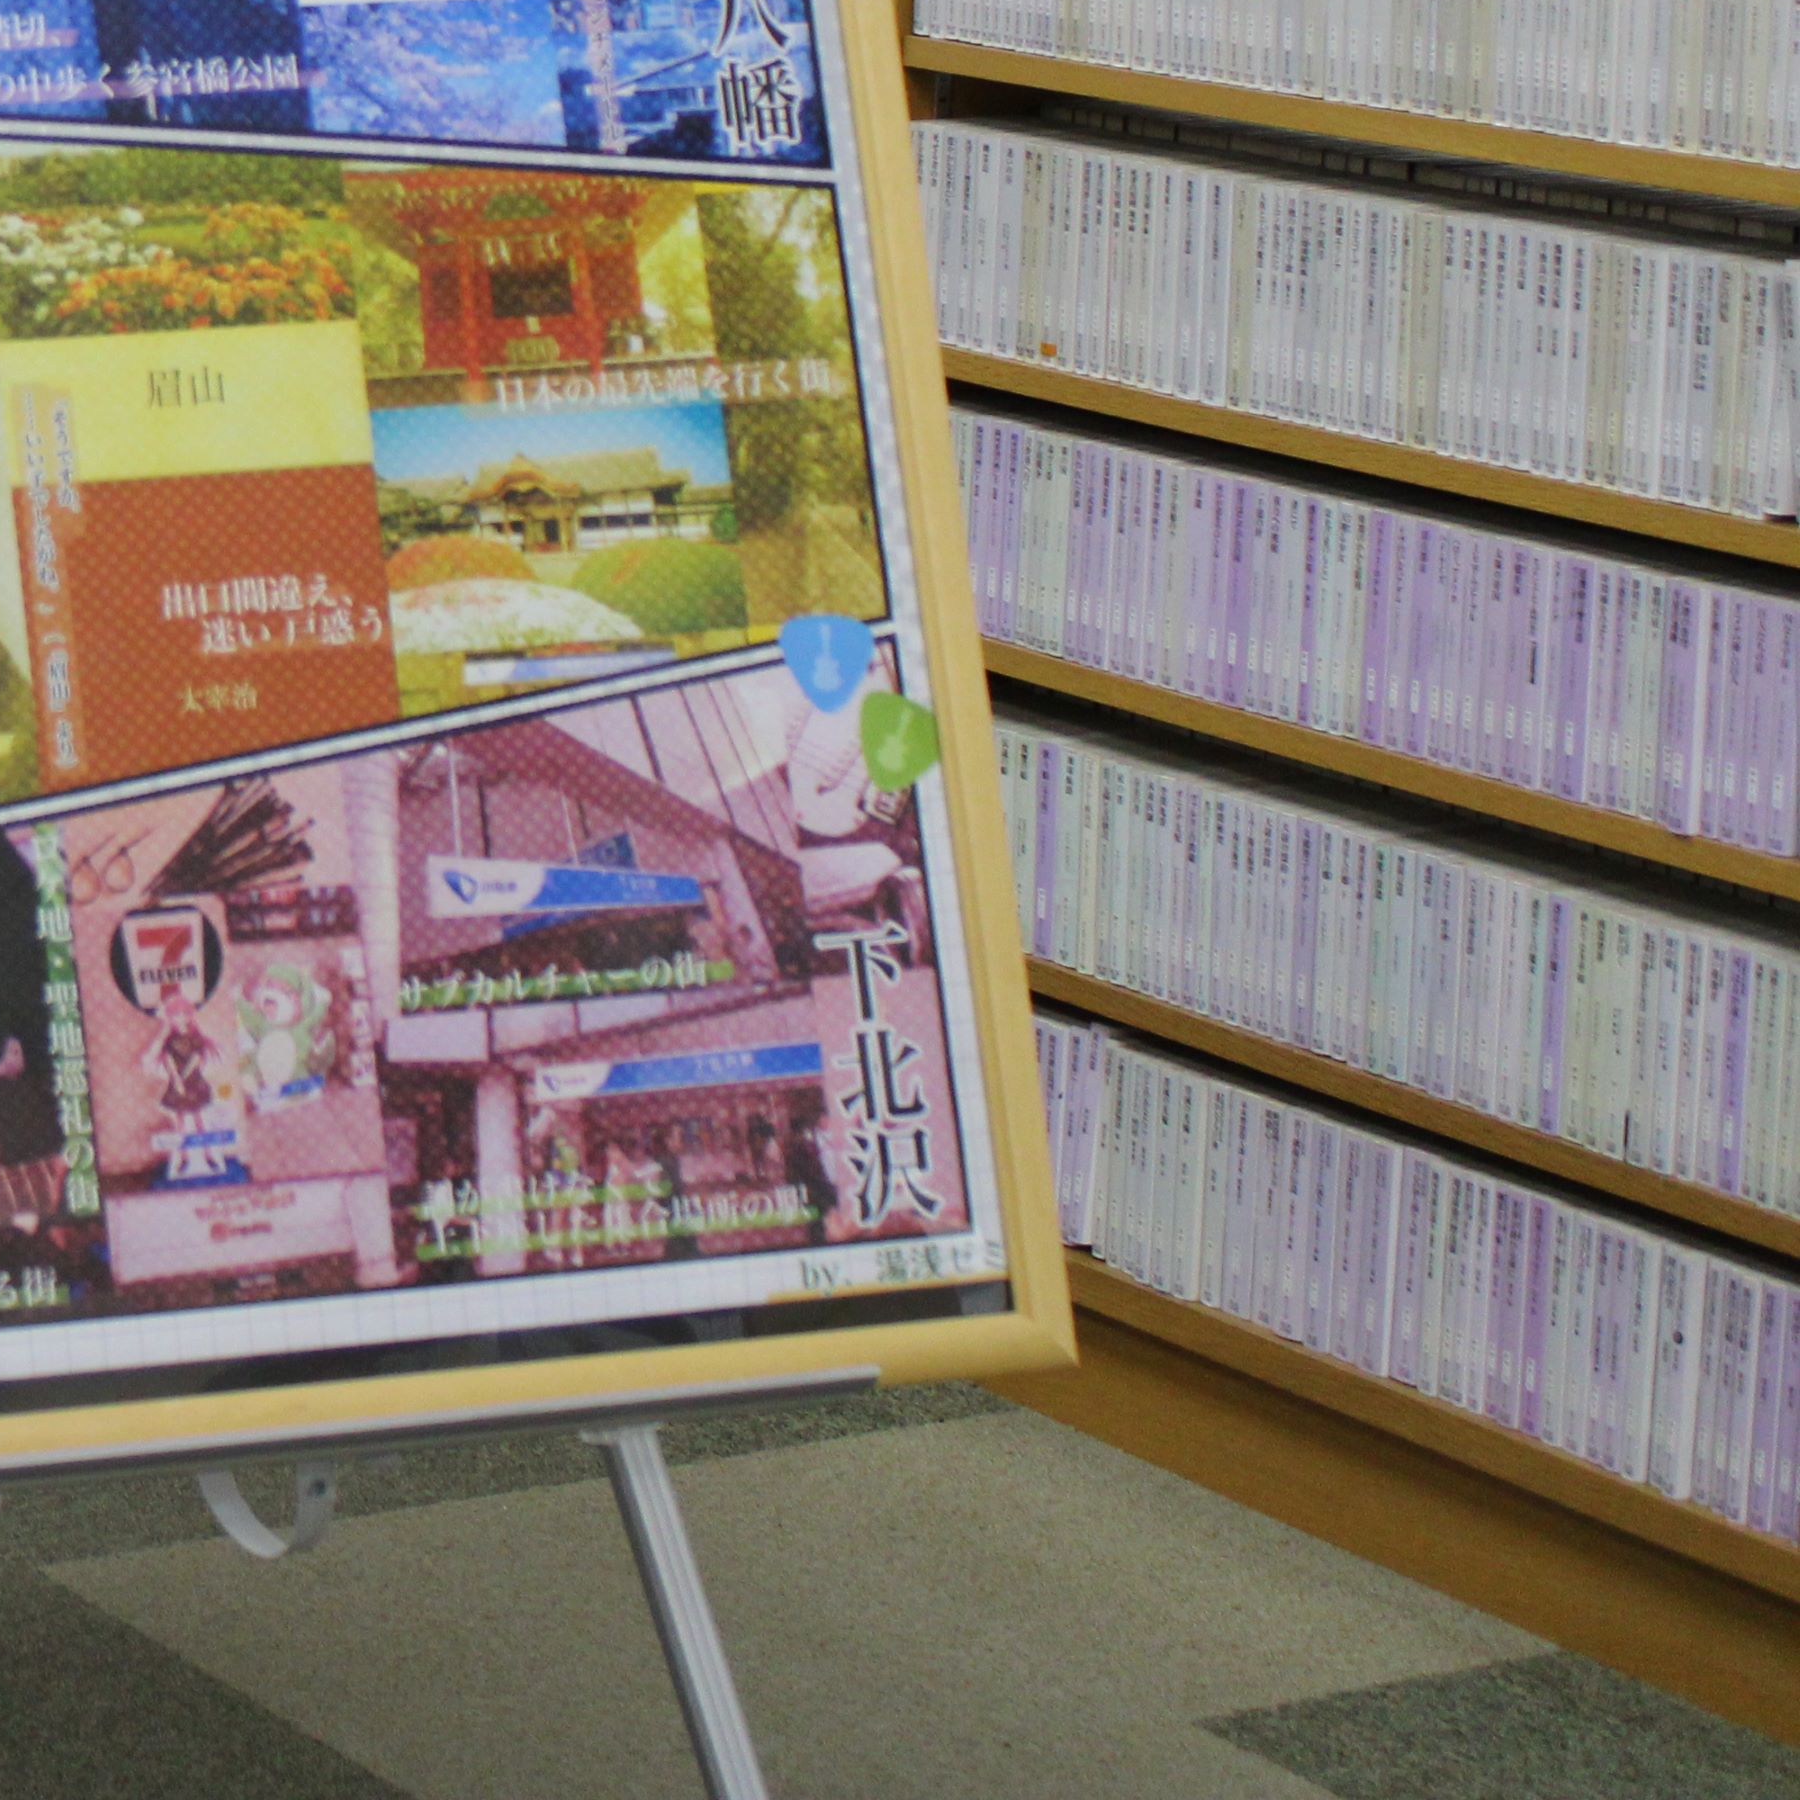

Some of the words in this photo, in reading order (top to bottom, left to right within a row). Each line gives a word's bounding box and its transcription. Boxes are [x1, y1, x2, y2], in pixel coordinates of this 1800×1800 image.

[147, 363, 227, 411] 眉山
[200, 606, 384, 656] 迷い戸惑う
[178, 683, 260, 714] 太宰治
[398, 950, 706, 1010] サブカルチャーの街
[814, 920, 944, 1228] 下北沢
